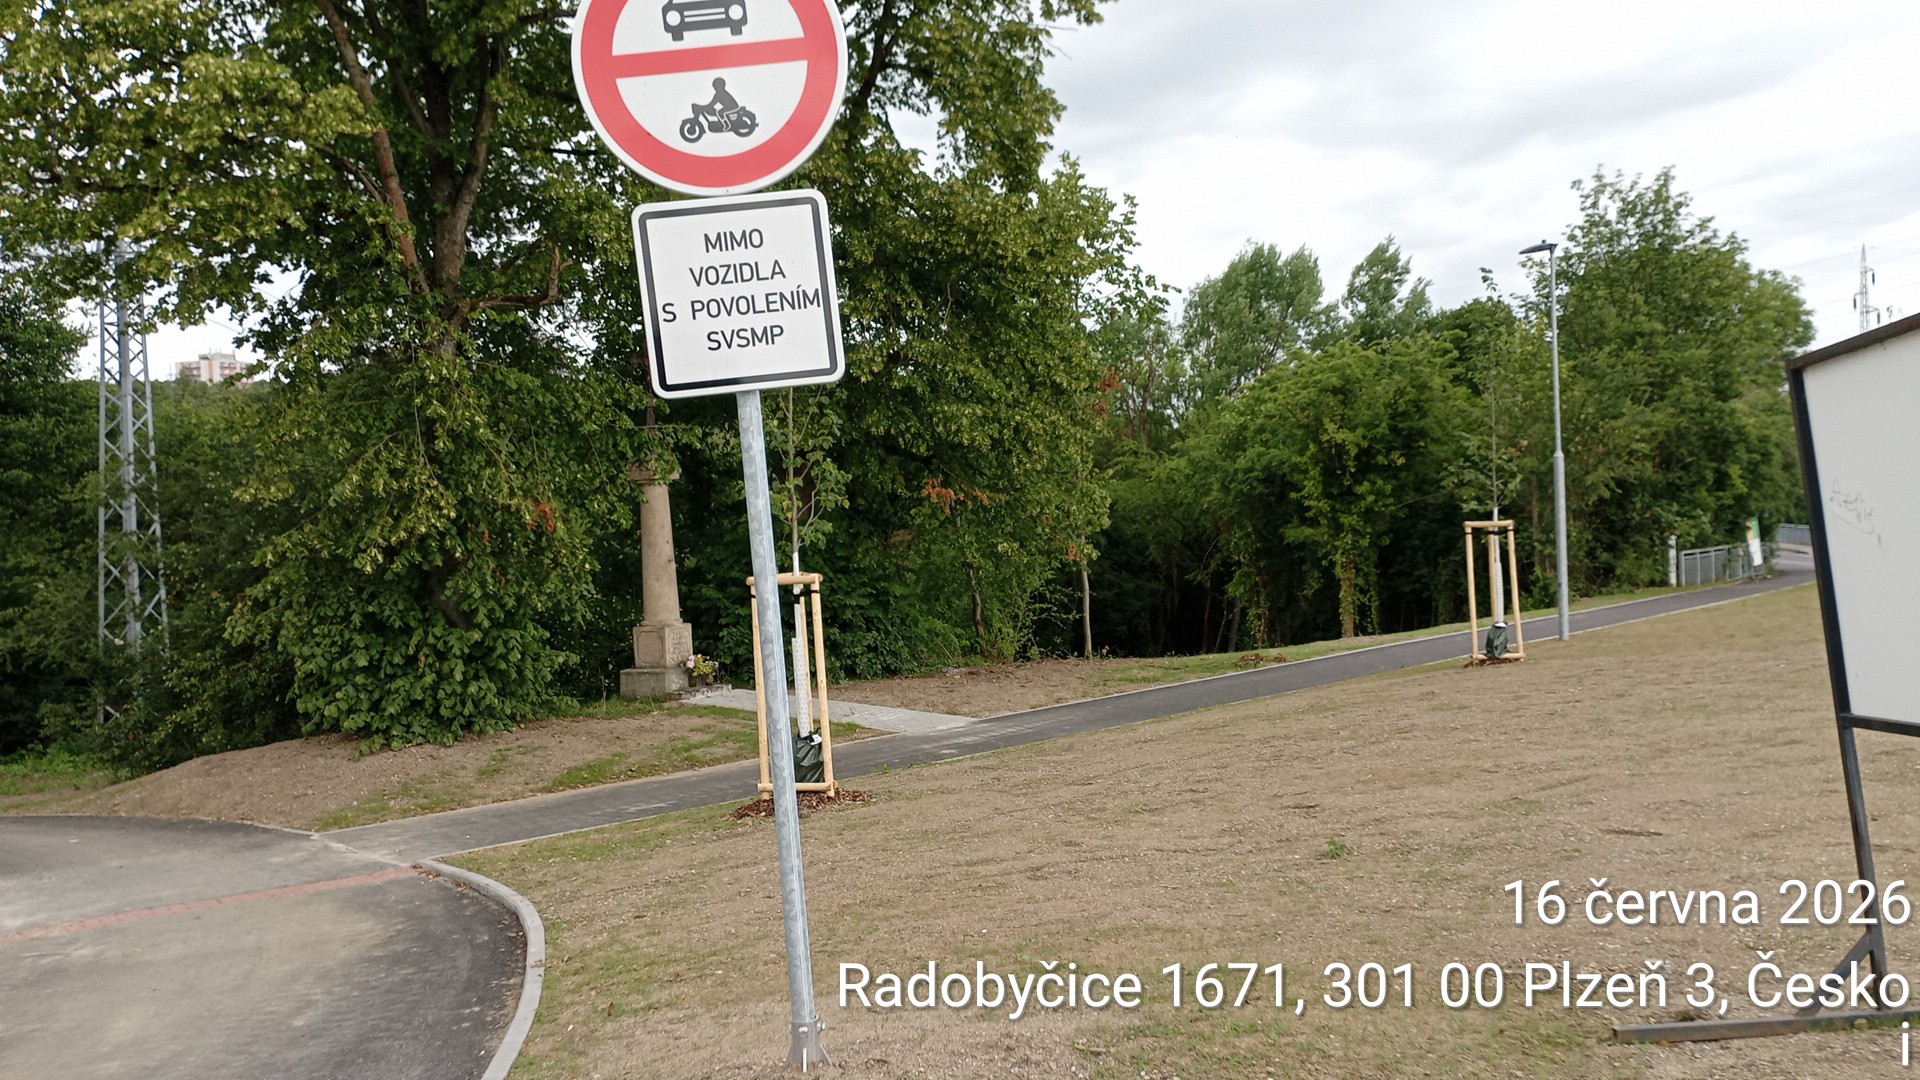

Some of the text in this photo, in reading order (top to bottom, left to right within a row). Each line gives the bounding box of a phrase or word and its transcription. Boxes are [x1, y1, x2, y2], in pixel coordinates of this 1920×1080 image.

[703, 228, 764, 254] MIMO
[688, 259, 787, 287] VOZIDLA
[661, 284, 822, 323] S POVOLENÍM
[706, 324, 785, 351] SVSMP
